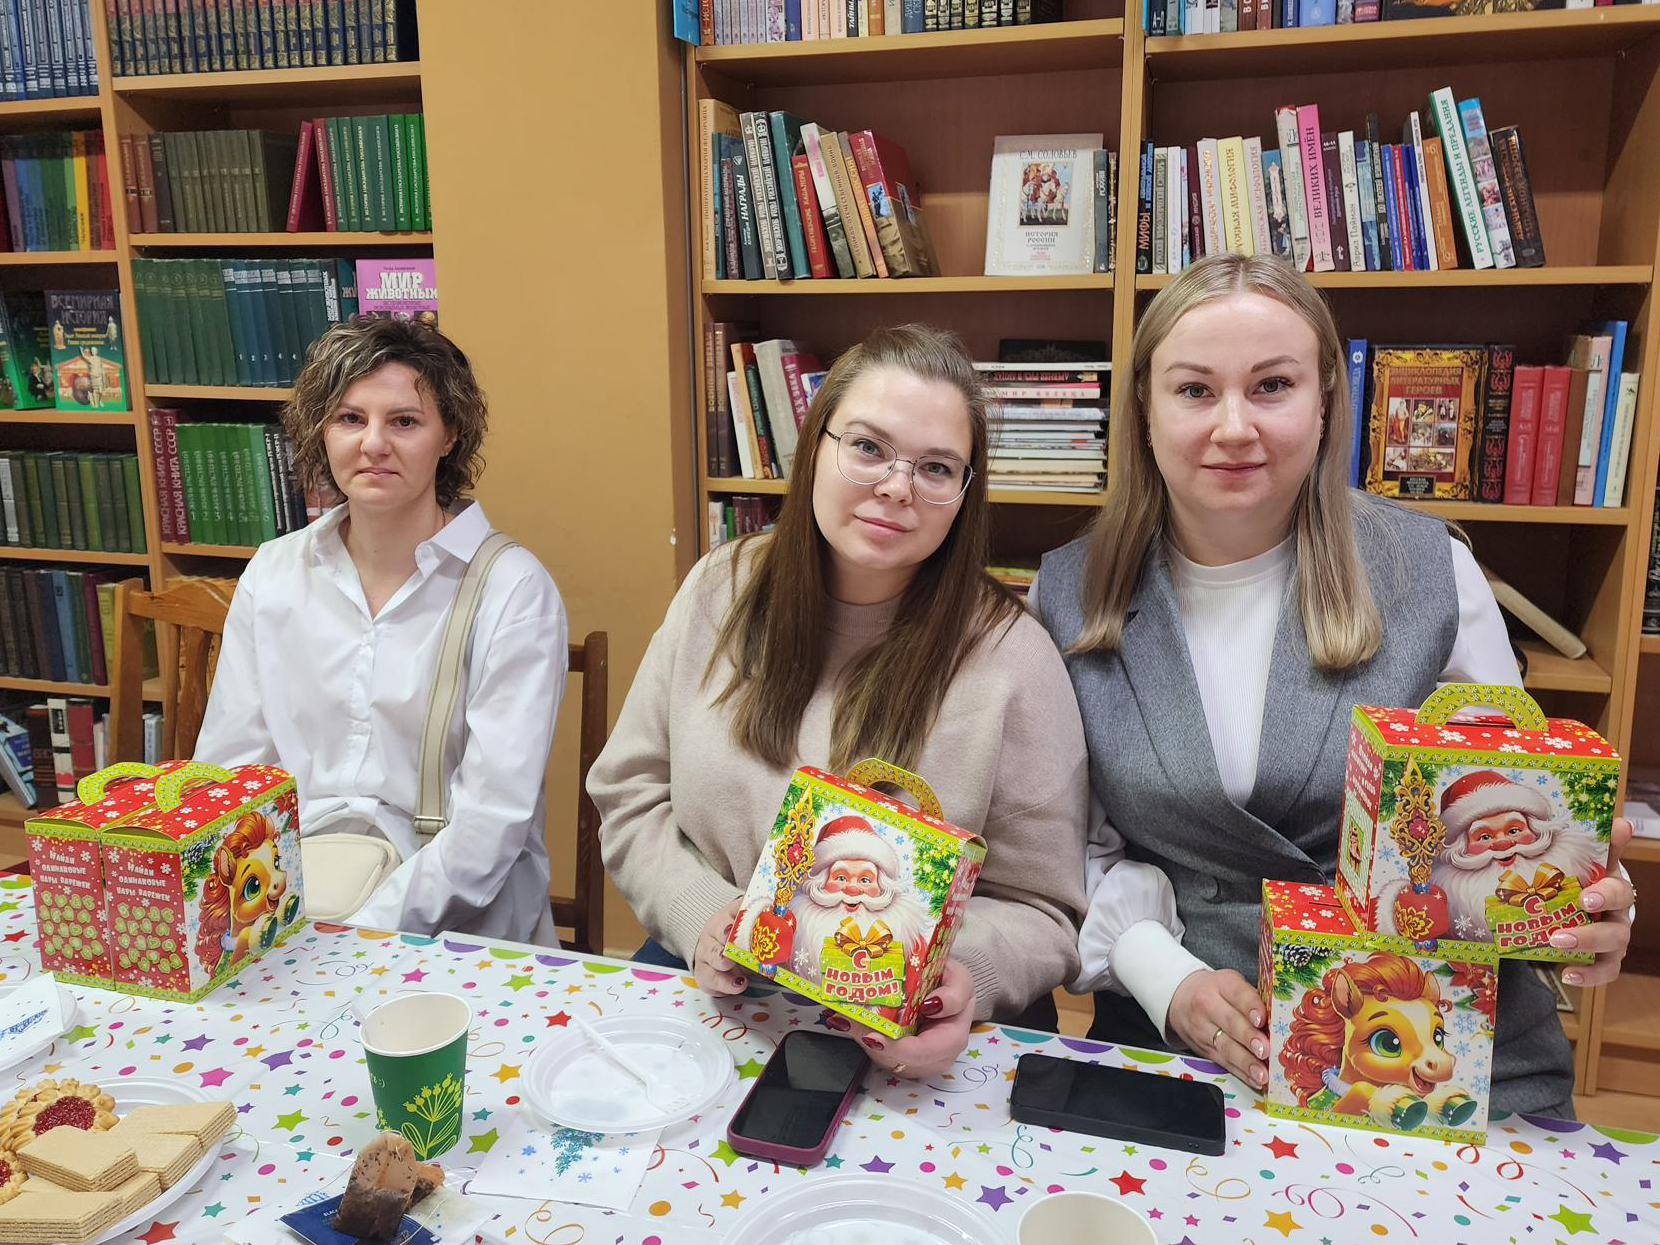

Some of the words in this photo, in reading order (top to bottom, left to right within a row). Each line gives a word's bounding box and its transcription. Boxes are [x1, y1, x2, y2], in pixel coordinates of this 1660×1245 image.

[1440, 98, 1460, 151] ПРЕДАНИЯ
[1304, 126, 1317, 160] ИМЁН
[1454, 152, 1461, 160] И
[1309, 164, 1323, 219] ВЕЛИКИХ
[1455, 161, 1473, 209] ЛЕГЕНДЫ
[736, 174, 749, 220] НАГРАДЫ
[1139, 212, 1151, 250] МИФЫ
[1467, 211, 1484, 254] РУССКИЕ
[380, 272, 423, 288] МИР
[51, 295, 114, 309] ВСЕМИРНАЯ
[366, 287, 438, 299] ЖИВОТНЫХ
[62, 311, 107, 324] ИСТОРИЯ
[1389, 367, 1462, 376] ЭНЦИКЛОПЕДИЯ
[1390, 376, 1461, 385] ЛИТЕРАТУРНЫХ
[1405, 385, 1443, 394] ГЕРОЕВ
[153, 428, 164, 454] СССР
[166, 429, 177, 454] СССР
[156, 457, 167, 488] КНИГА
[170, 457, 182, 489] КНИГА
[174, 491, 187, 535] КРАСНАЯ
[190, 511, 196, 521] 1
[202, 511, 209, 521] 2
[214, 511, 221, 521] 3
[227, 511, 234, 521] 4
[263, 514, 270, 522] 6
[1524, 895, 1544, 916] С
[1497, 902, 1577, 934] НОВЫМ
[852, 949, 869, 970] С
[825, 966, 895, 984] НОВЫМ
[825, 980, 899, 1002] ГОДОМ!
